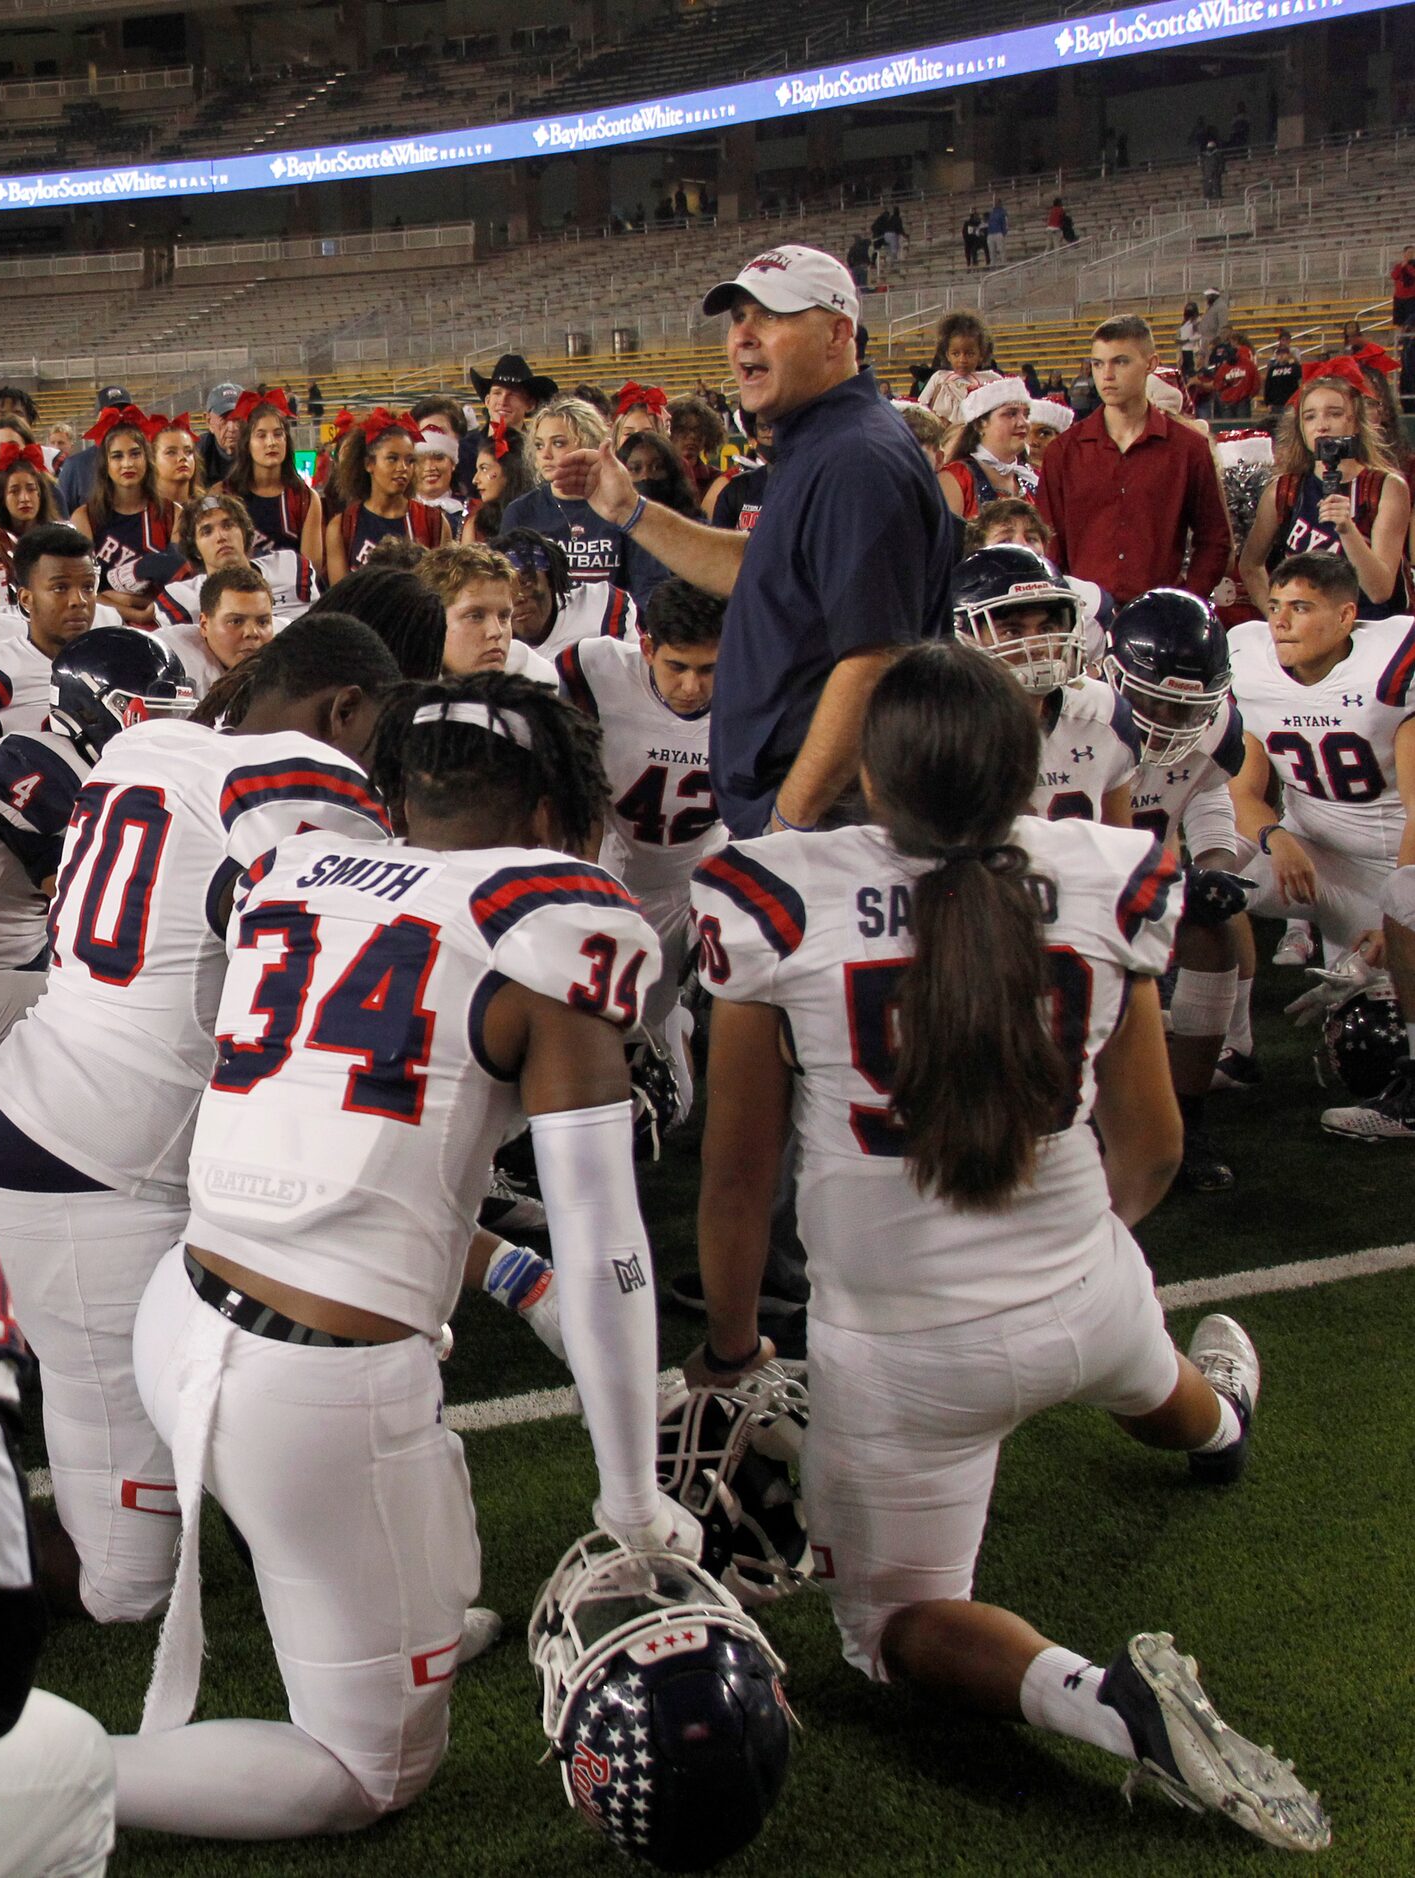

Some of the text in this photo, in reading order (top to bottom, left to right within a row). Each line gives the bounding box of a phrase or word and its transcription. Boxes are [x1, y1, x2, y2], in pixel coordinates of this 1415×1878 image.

[1074, 0, 1264, 57] BaylorScott&White
[791, 55, 1006, 107] BaylorScott&White HEALTH
[550, 105, 736, 149] BaylorScott&White HEALTH
[285, 143, 492, 181] BaylorScott&White HEALTH
[8, 173, 229, 206] BaylorScott&White HEALTH
[97, 536, 137, 567] RY
[554, 539, 613, 553] AIDER
[1286, 518, 1341, 553] RYA
[566, 553, 621, 568] TBALL
[1014, 582, 1050, 593] Riddell
[1167, 679, 1201, 692] Riddell
[1294, 715, 1331, 728] RYAN
[661, 749, 703, 765] RYAN
[1265, 731, 1388, 801] 38
[10, 772, 46, 812] 4
[1037, 771, 1058, 786] AN
[615, 764, 720, 846] 42
[1130, 794, 1150, 808] AN
[296, 853, 430, 903] SMITH
[857, 884, 1057, 939] SAD
[567, 932, 648, 1030] 34
[210, 900, 441, 1126] 34
